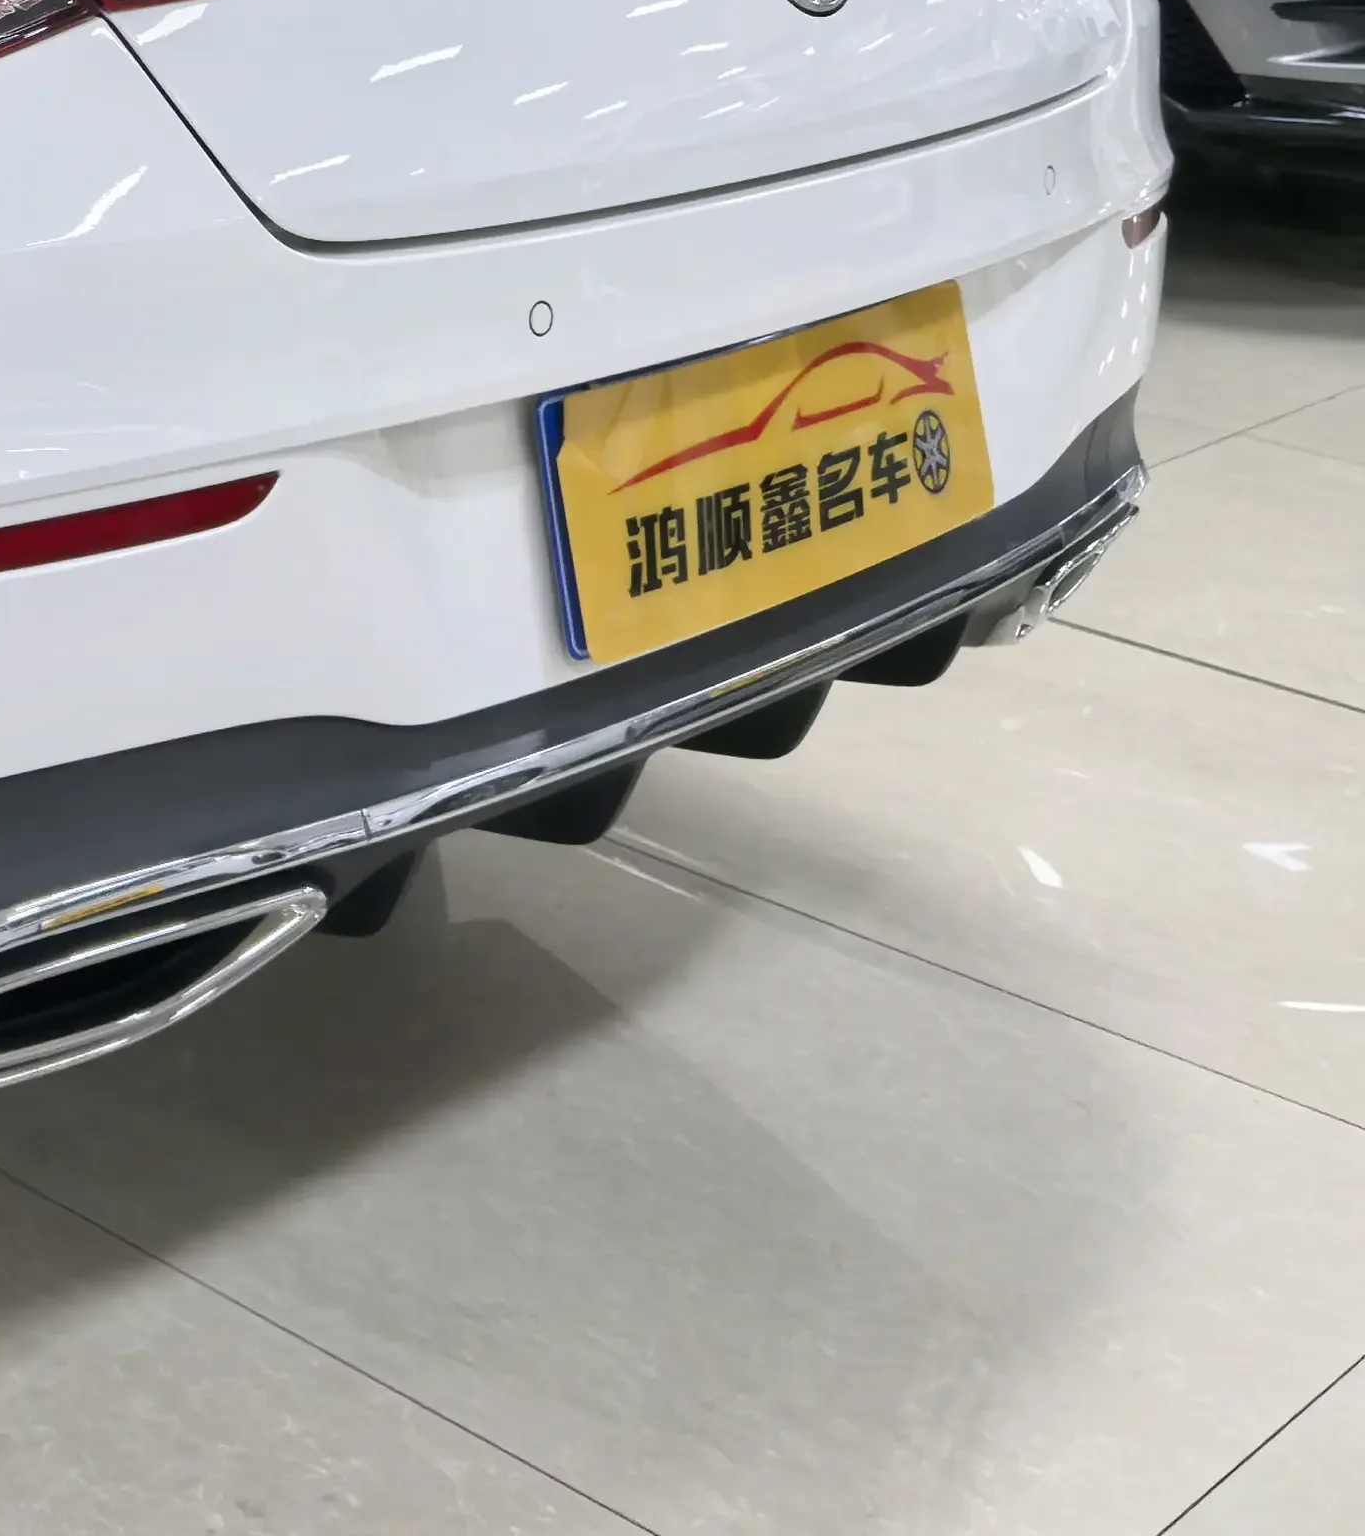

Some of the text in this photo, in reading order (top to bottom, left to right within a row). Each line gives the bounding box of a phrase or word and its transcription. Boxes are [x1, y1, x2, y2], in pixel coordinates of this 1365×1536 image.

[625, 431, 912, 598] 鸿顺鑫名车
